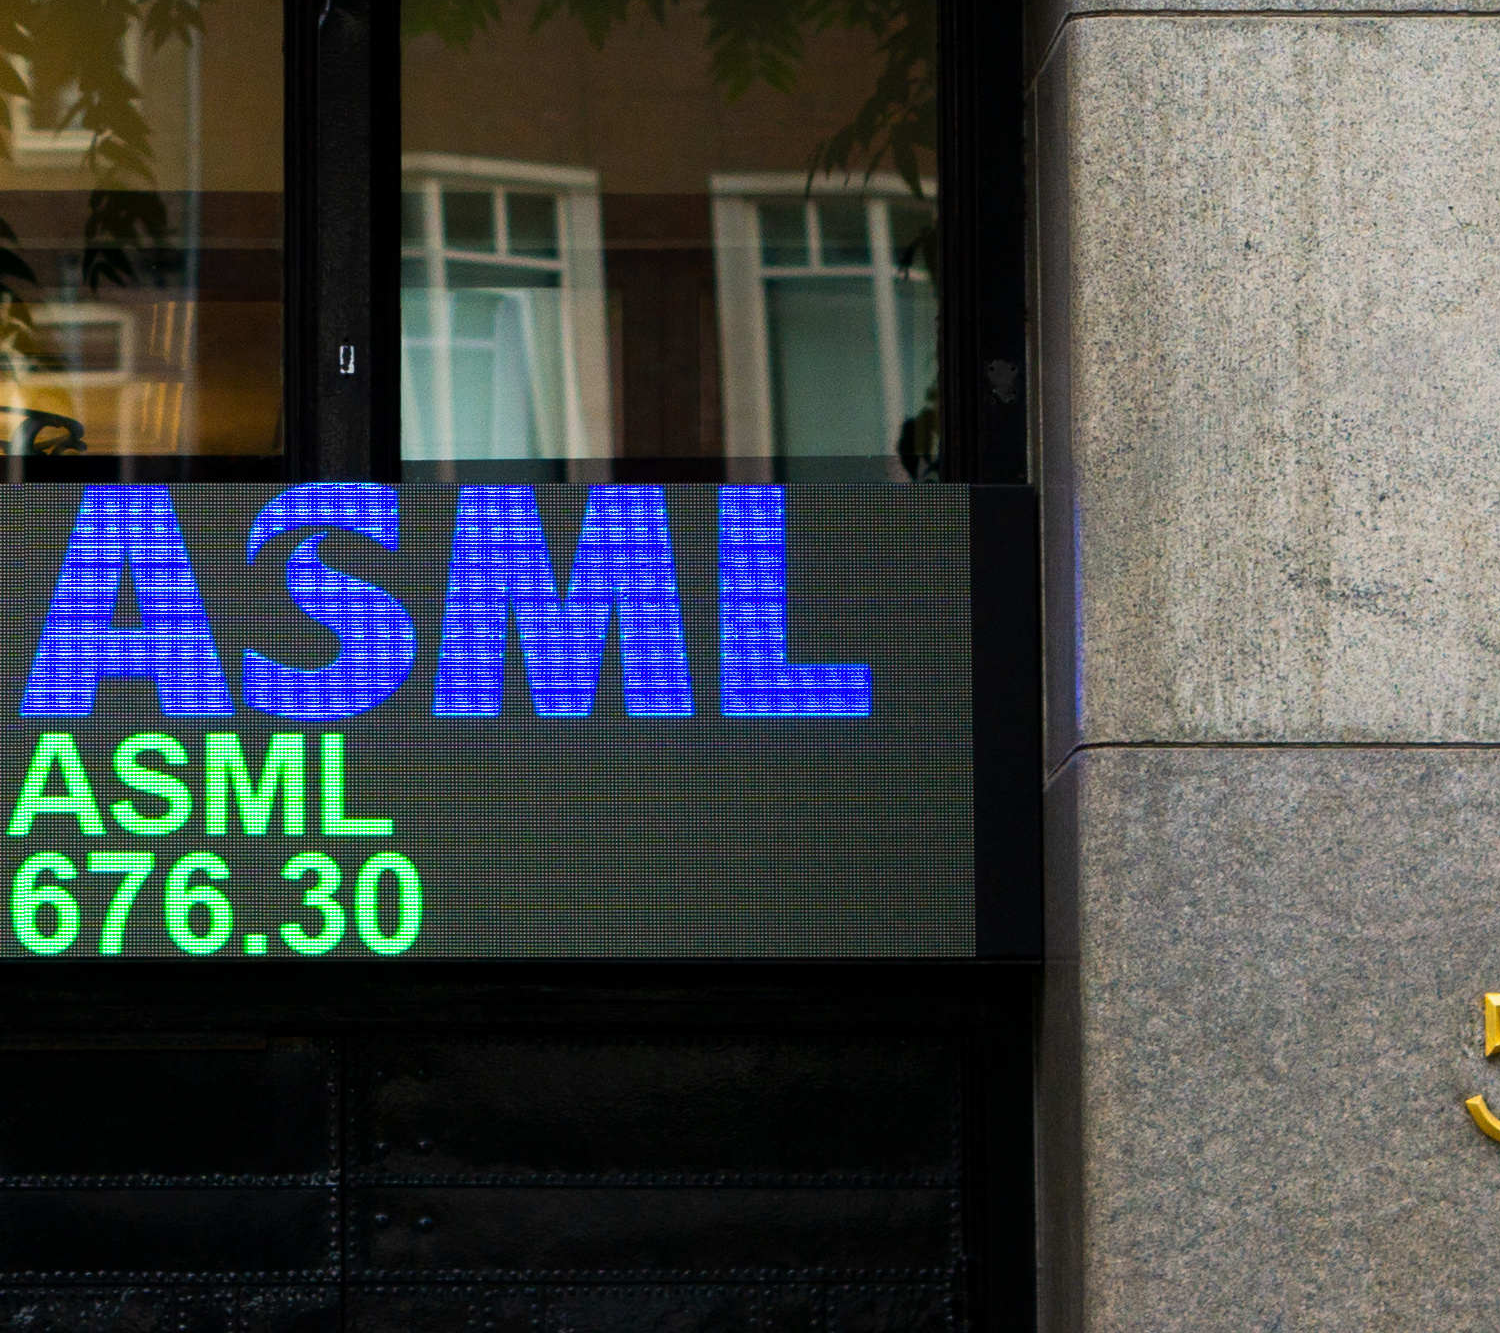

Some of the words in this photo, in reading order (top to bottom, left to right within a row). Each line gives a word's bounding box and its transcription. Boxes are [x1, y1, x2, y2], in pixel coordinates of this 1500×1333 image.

[19, 482, 873, 722] ASML
[7, 732, 394, 836] ASML
[10, 851, 424, 955] 676.30
